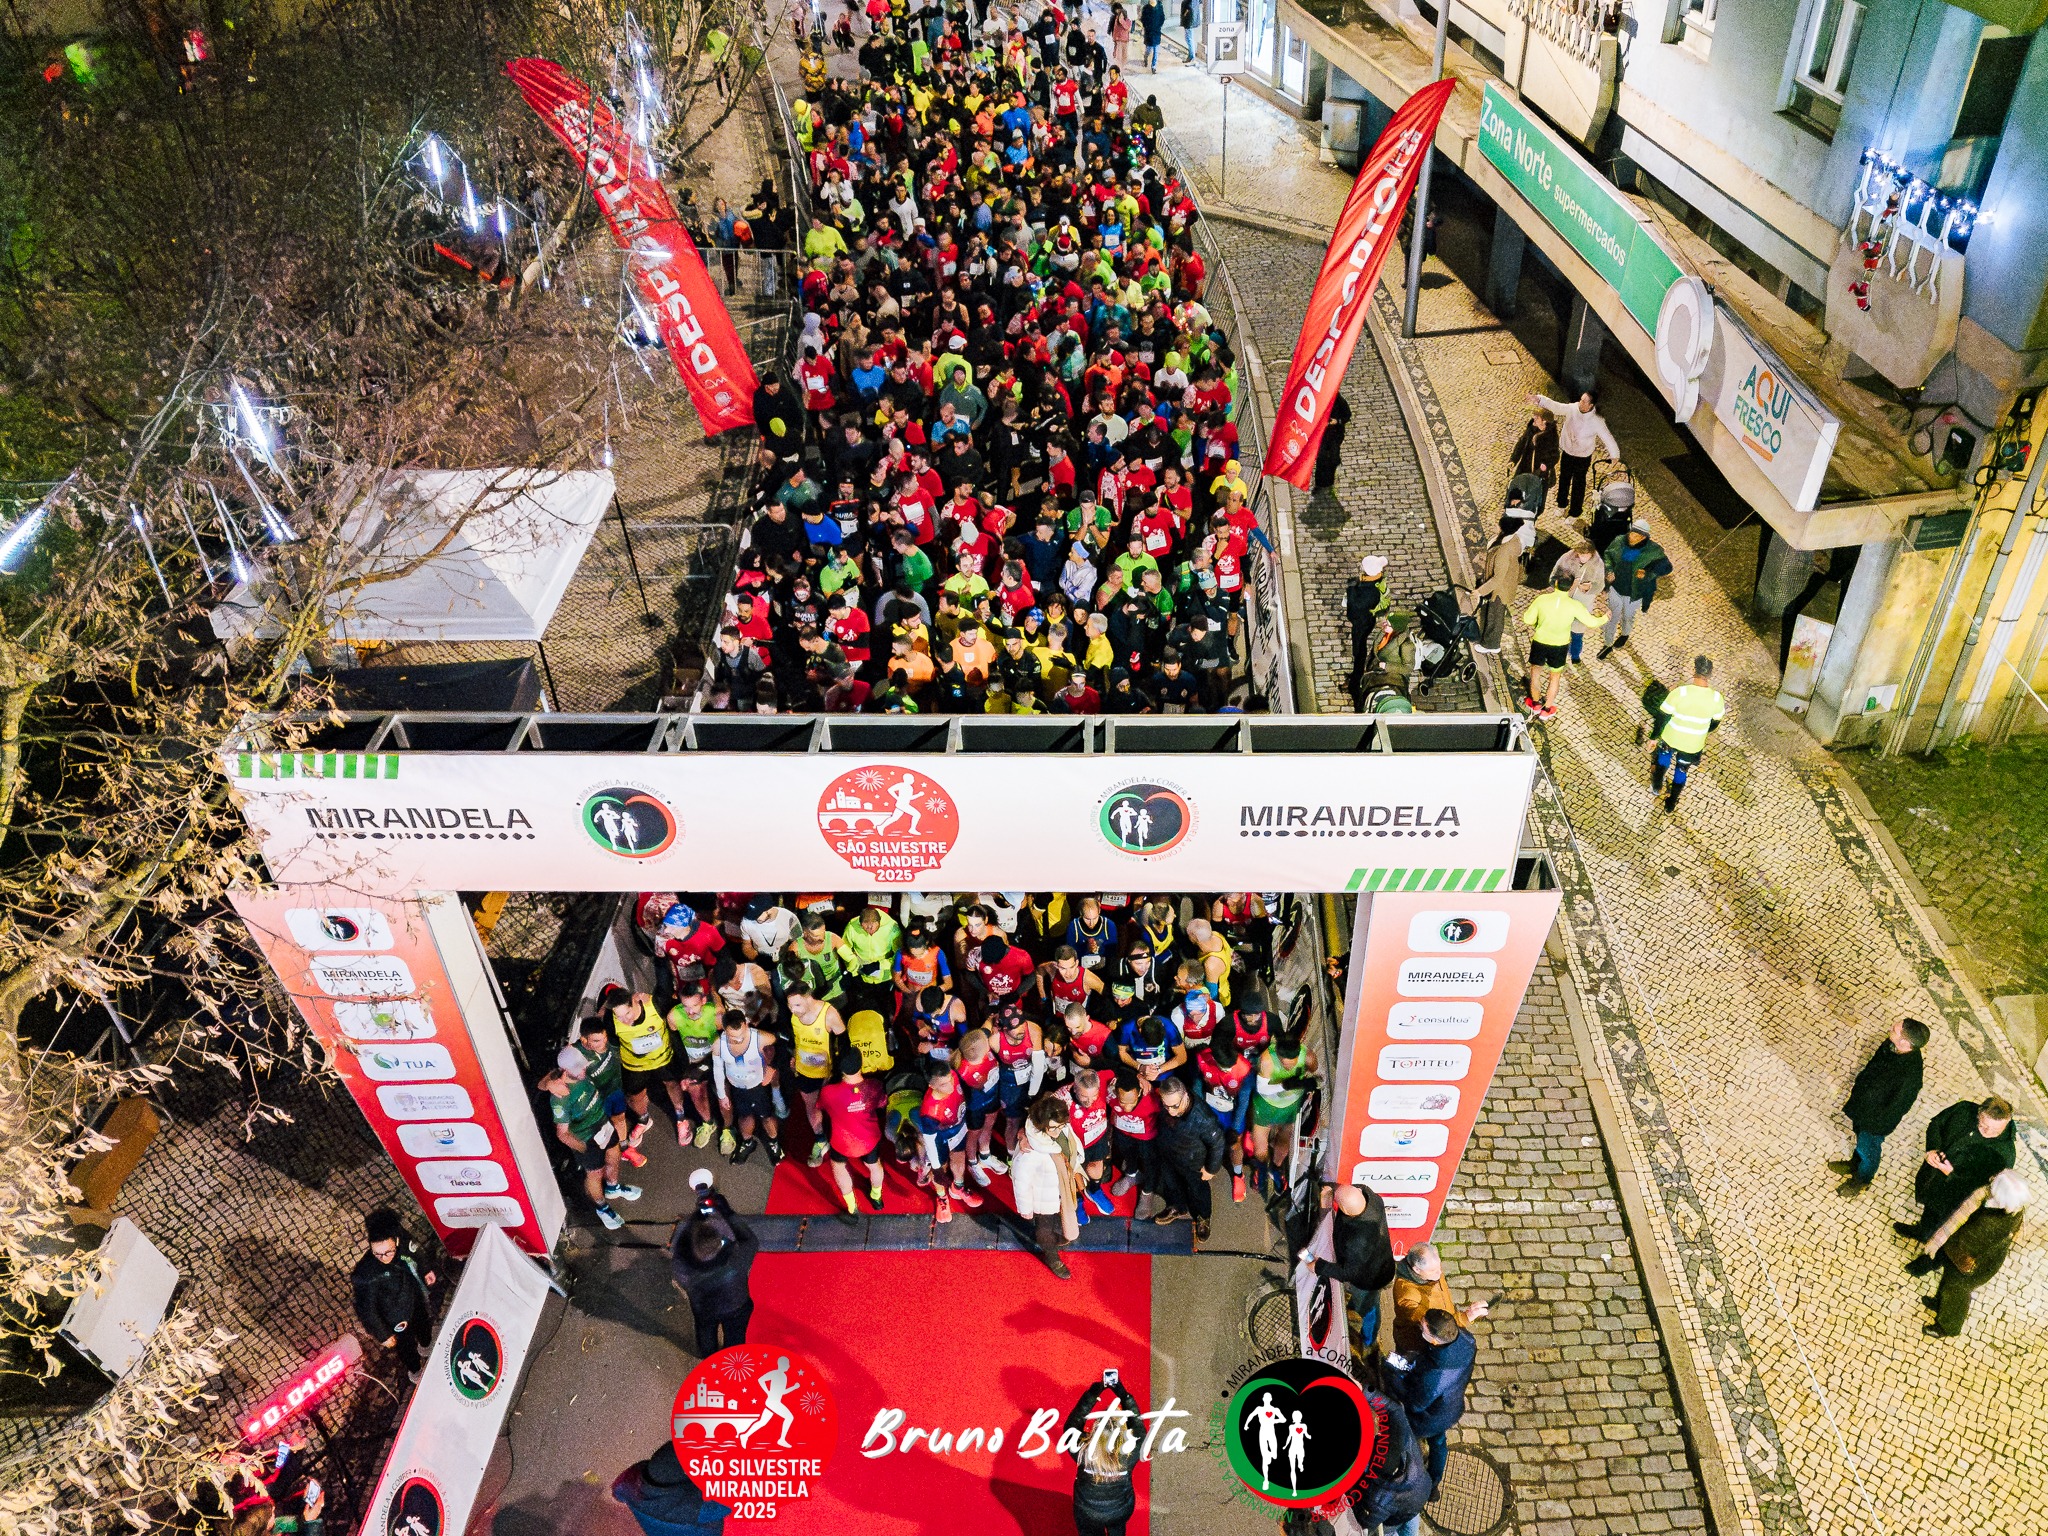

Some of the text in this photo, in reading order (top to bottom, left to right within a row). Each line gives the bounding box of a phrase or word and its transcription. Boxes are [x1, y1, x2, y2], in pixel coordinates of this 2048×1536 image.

[1220, 39, 1233, 60] P
[1481, 97, 1627, 267] Zona Norte supermercados
[1742, 364, 1792, 426] AQUI
[1732, 394, 1782, 454] FRESCO
[306, 807, 534, 830] MIRANDELA
[1239, 805, 1461, 827] MIRANDELA
[836, 838, 948, 854] SÃO SILVESTRE
[852, 855, 938, 868] MIRANDELA
[876, 869, 913, 881] 2025
[1407, 971, 1485, 979] MIRANDELA
[403, 1060, 435, 1070] TUA
